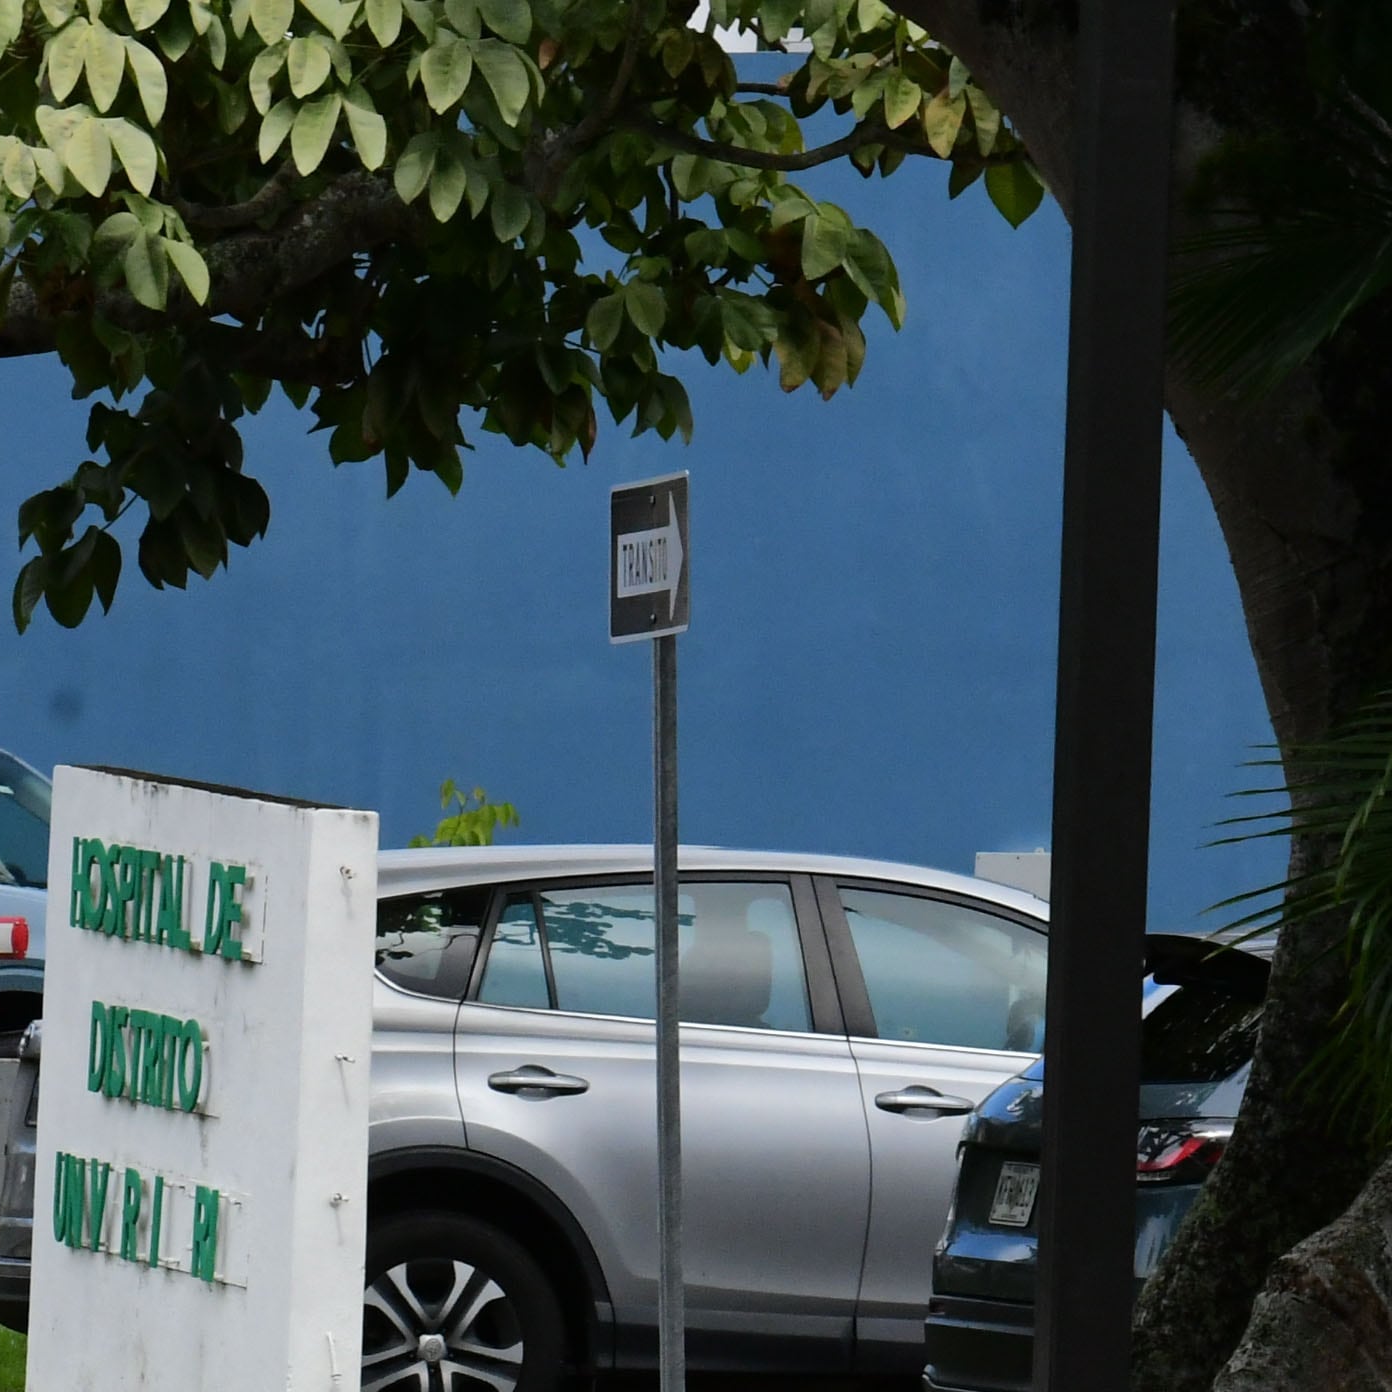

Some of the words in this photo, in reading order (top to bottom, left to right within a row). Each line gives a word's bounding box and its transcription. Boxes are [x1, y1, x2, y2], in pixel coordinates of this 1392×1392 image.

[622, 537, 669, 588] TRANSITO
[69, 835, 191, 951] HOSPITAL
[203, 861, 246, 961] DE
[87, 1000, 204, 1113] DISTRITO
